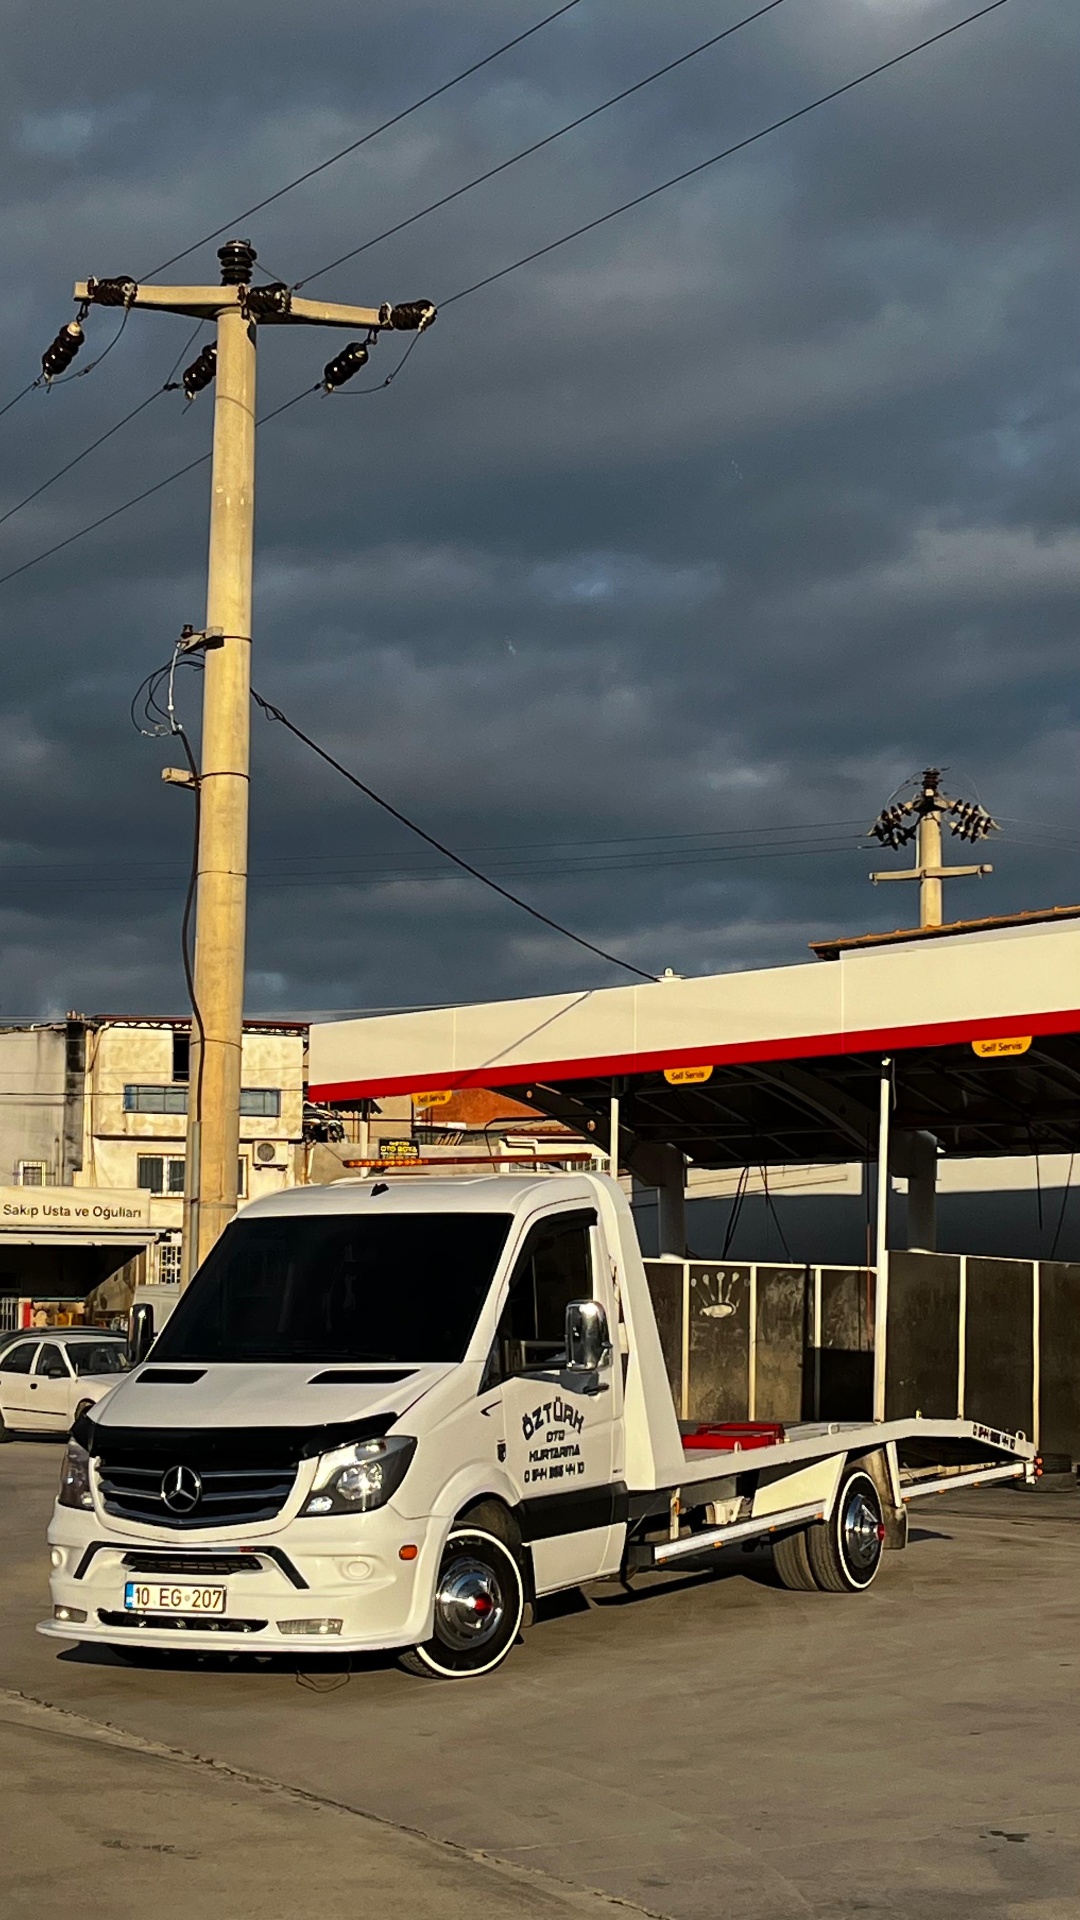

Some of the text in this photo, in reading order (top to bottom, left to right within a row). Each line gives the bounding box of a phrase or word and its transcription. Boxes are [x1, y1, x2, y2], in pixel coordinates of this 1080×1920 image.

[998, 1041, 1022, 1052] Servis
[3, 1204, 142, 1220] Sakıp Usta ve Oğulları
[522, 1396, 585, 1441] ÖZTÜRK
[546, 1429, 566, 1443] OTO
[528, 1443, 581, 1463] KURTARMA
[135, 1587, 222, 1609] 10 EG 207
